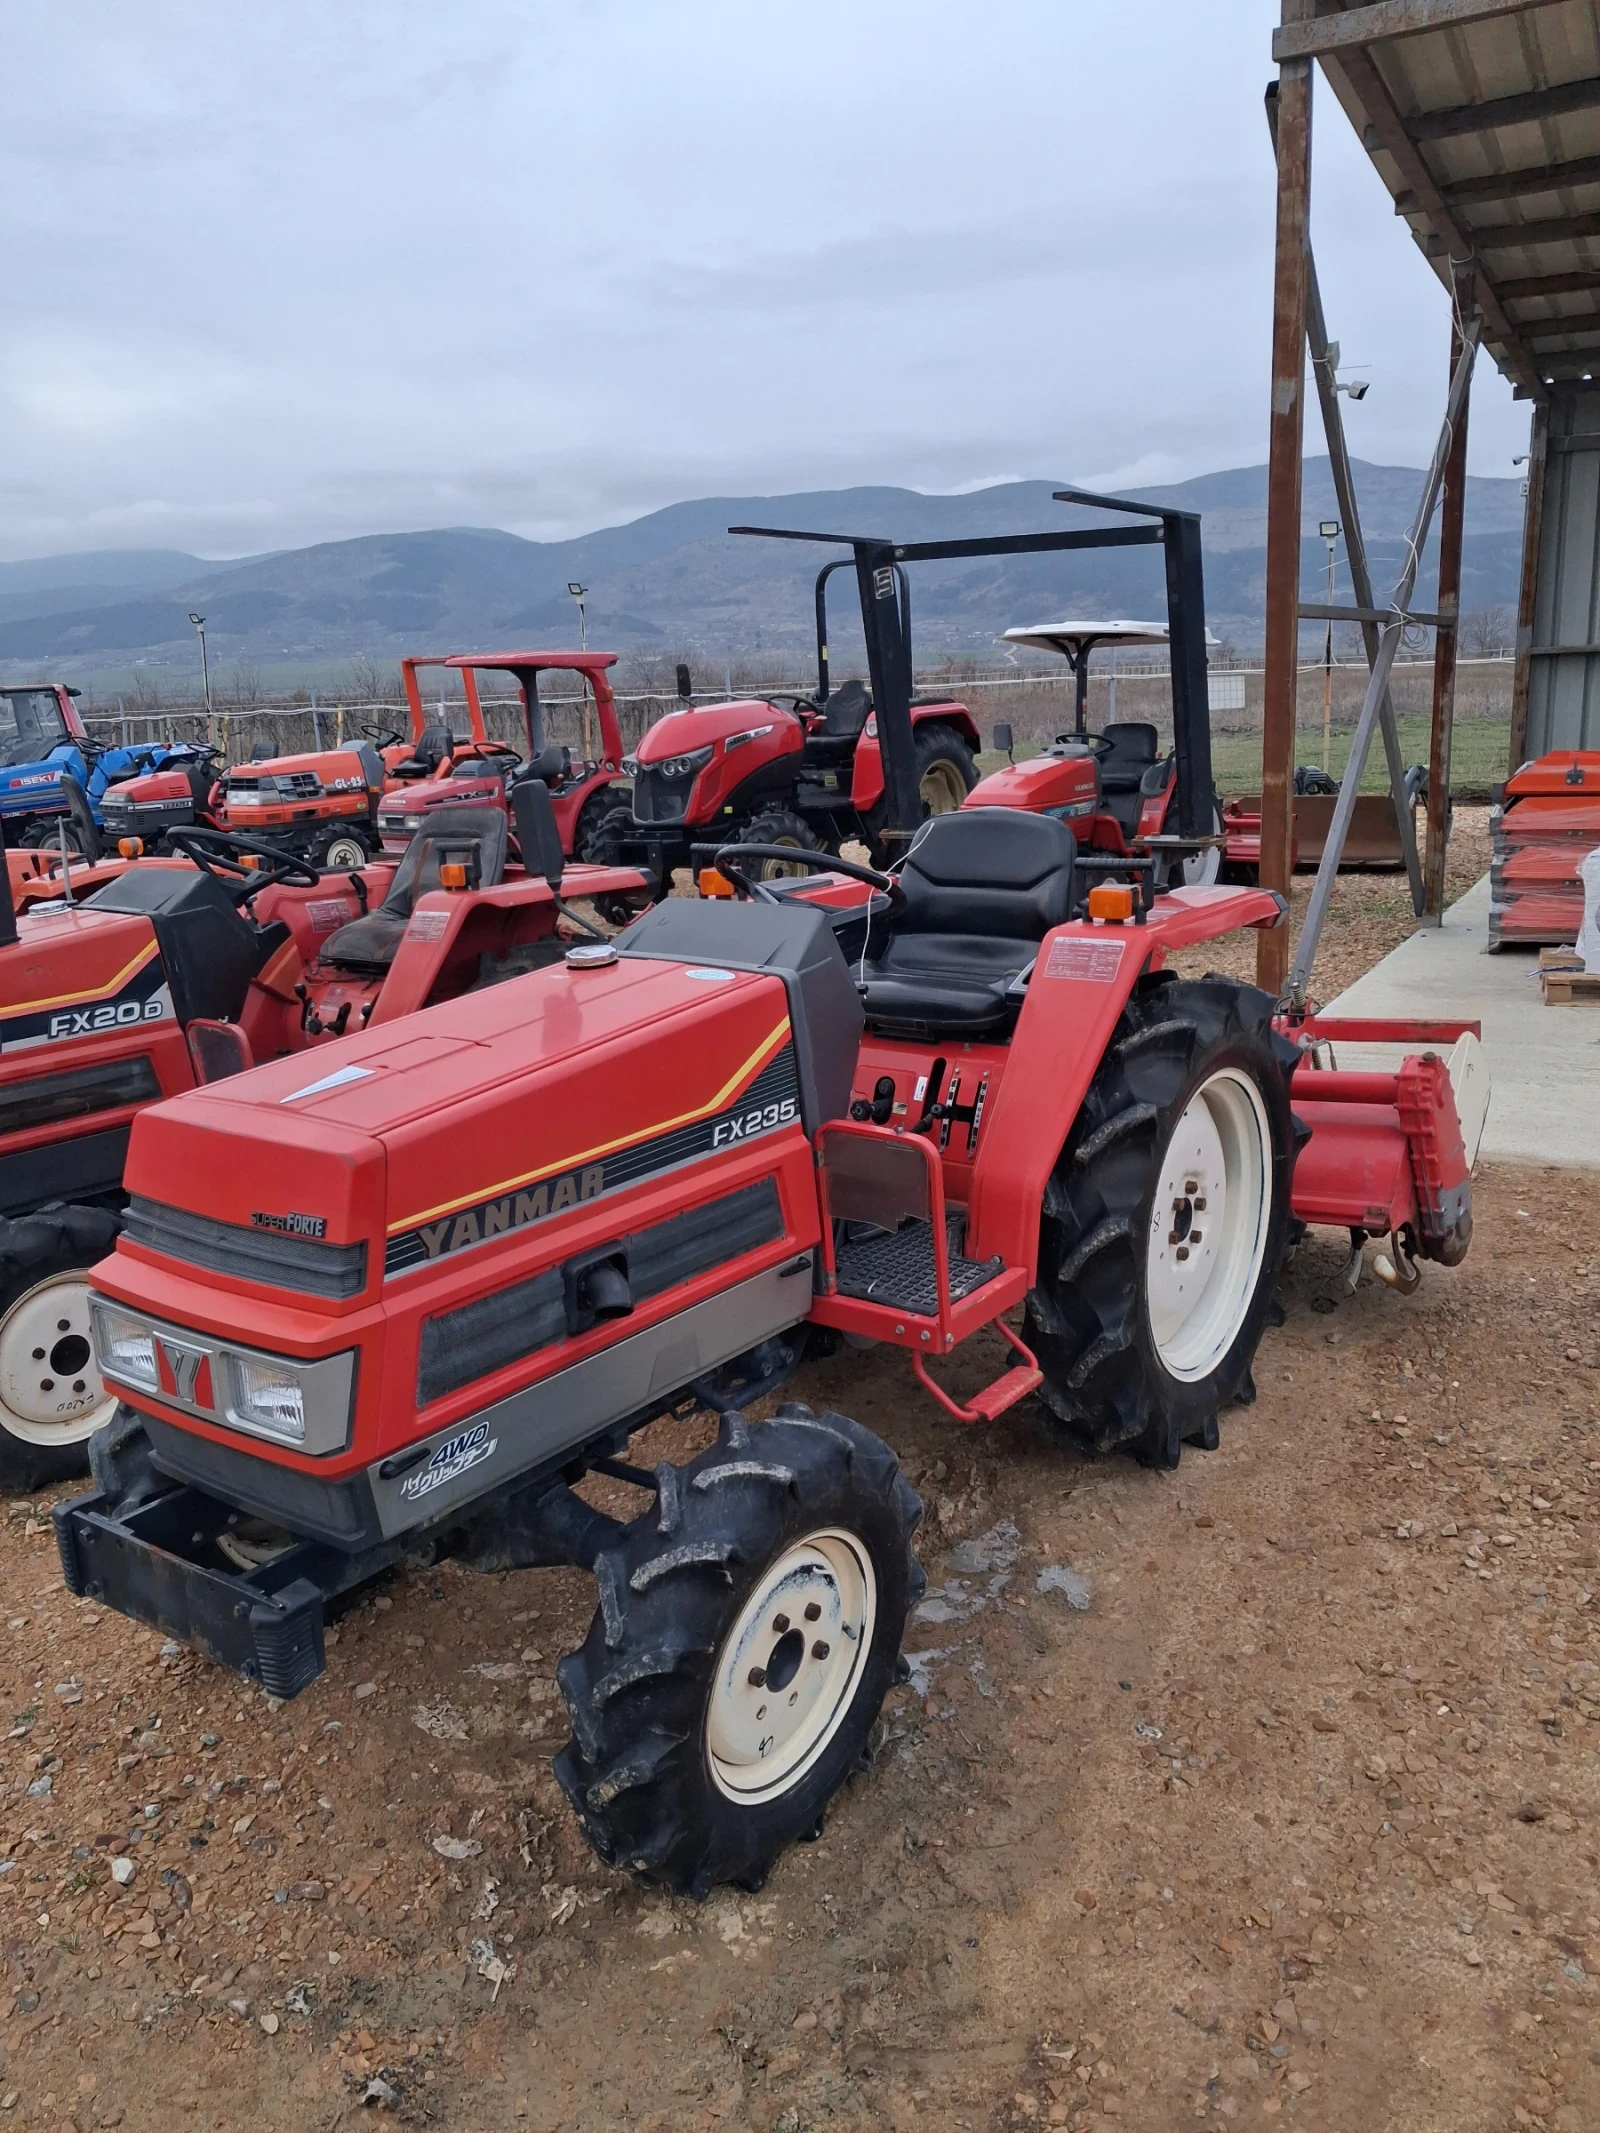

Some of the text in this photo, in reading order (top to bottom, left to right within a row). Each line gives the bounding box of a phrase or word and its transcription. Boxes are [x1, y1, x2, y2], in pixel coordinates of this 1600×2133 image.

[20, 775, 52, 786] ISEKI
[712, 1097, 797, 1148] FX235
[286, 1212, 324, 1238] FORTE
[418, 1166, 605, 1259] YANMAR
[428, 1421, 490, 1470] 4WD
